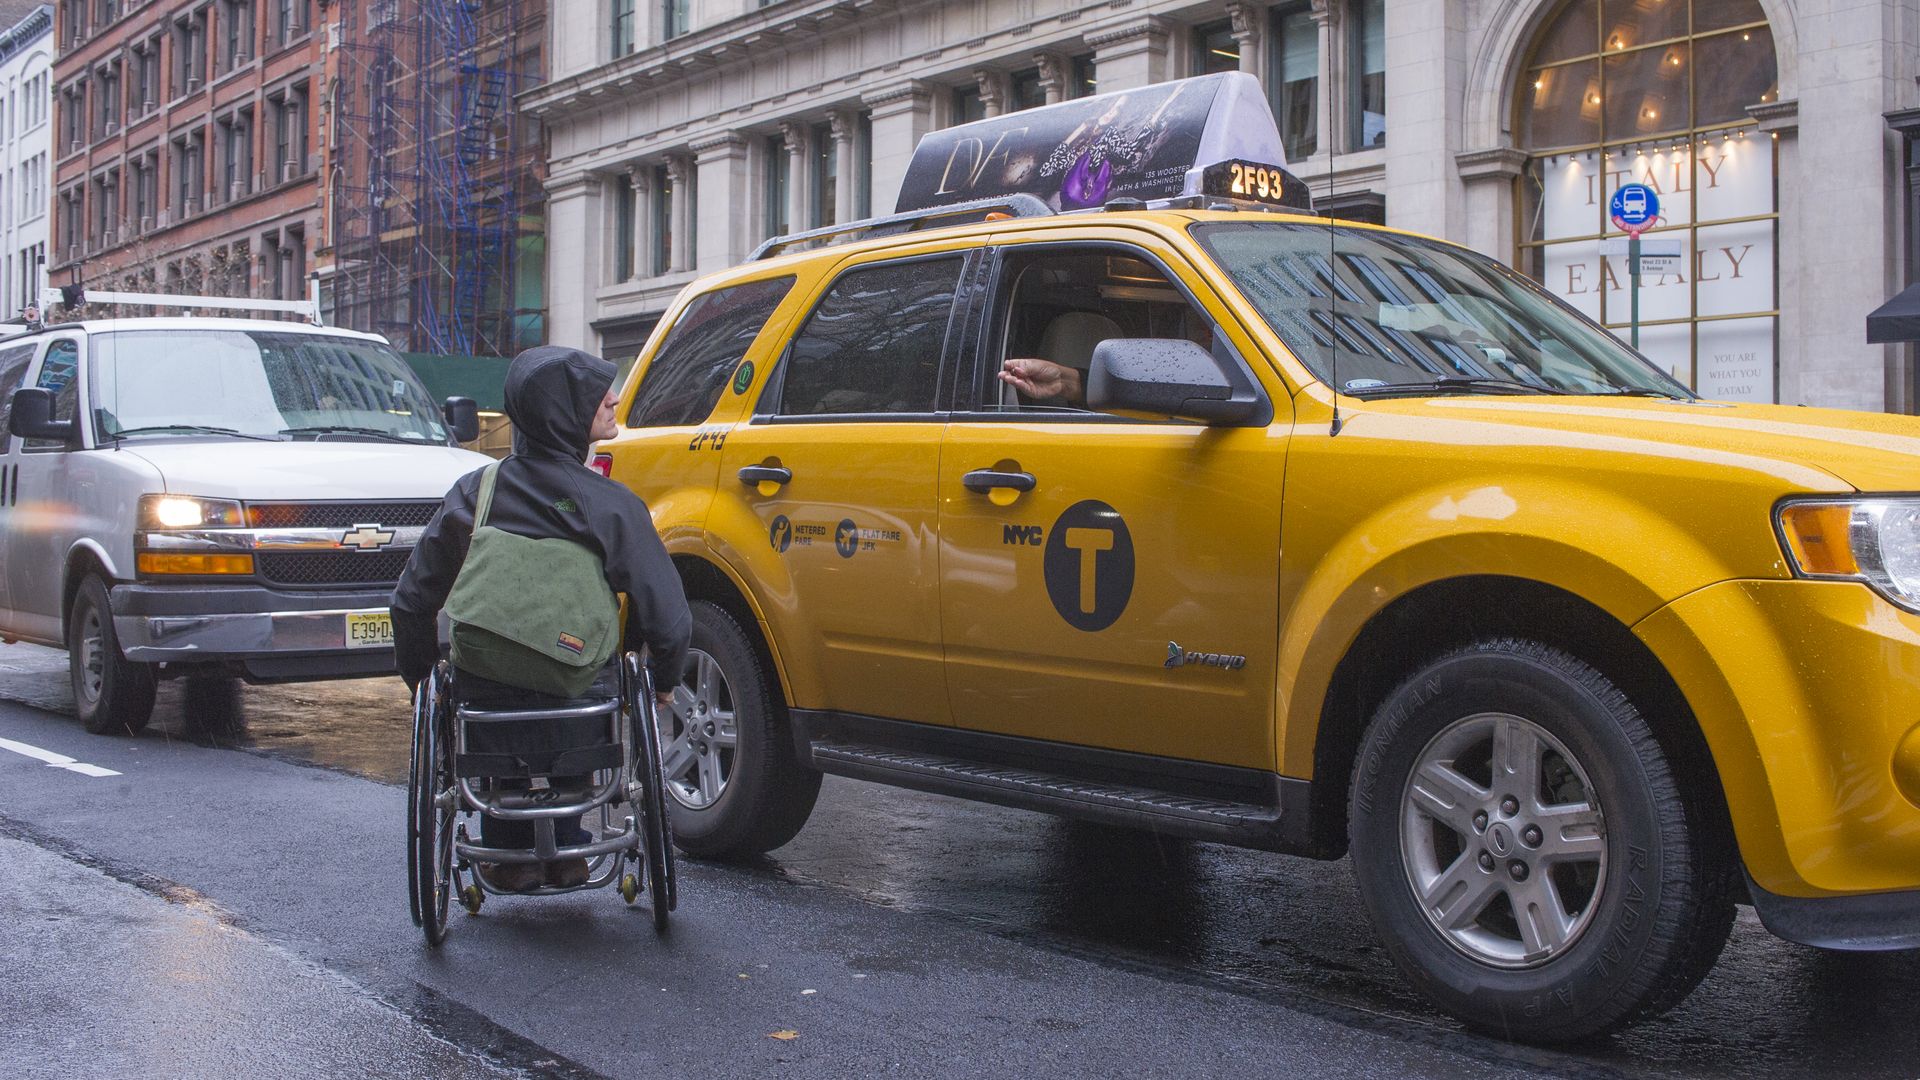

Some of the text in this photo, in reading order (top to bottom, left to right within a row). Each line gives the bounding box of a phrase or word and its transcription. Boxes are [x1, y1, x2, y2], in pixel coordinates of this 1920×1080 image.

[1157, 164, 1191, 177] WOOSTER
[1141, 174, 1185, 188] WASHINGTO
[1231, 163, 1283, 200] 2F93
[1585, 154, 1728, 206] ITALY
[1714, 352, 1757, 363] YOU ARE
[1709, 369, 1761, 379] WHAT YOU
[1717, 385, 1752, 395] EATALY
[795, 525, 826, 536] METERED
[861, 529, 900, 541] FLAT FARE
[1003, 525, 1043, 546] NYC
[794, 536, 812, 546] FARE
[861, 541, 876, 552] JFK
[1065, 527, 1114, 614] T
[1186, 651, 1246, 670] HYBRID
[1358, 672, 1444, 813] IRONMAN
[1585, 843, 1648, 978] RADIAL
